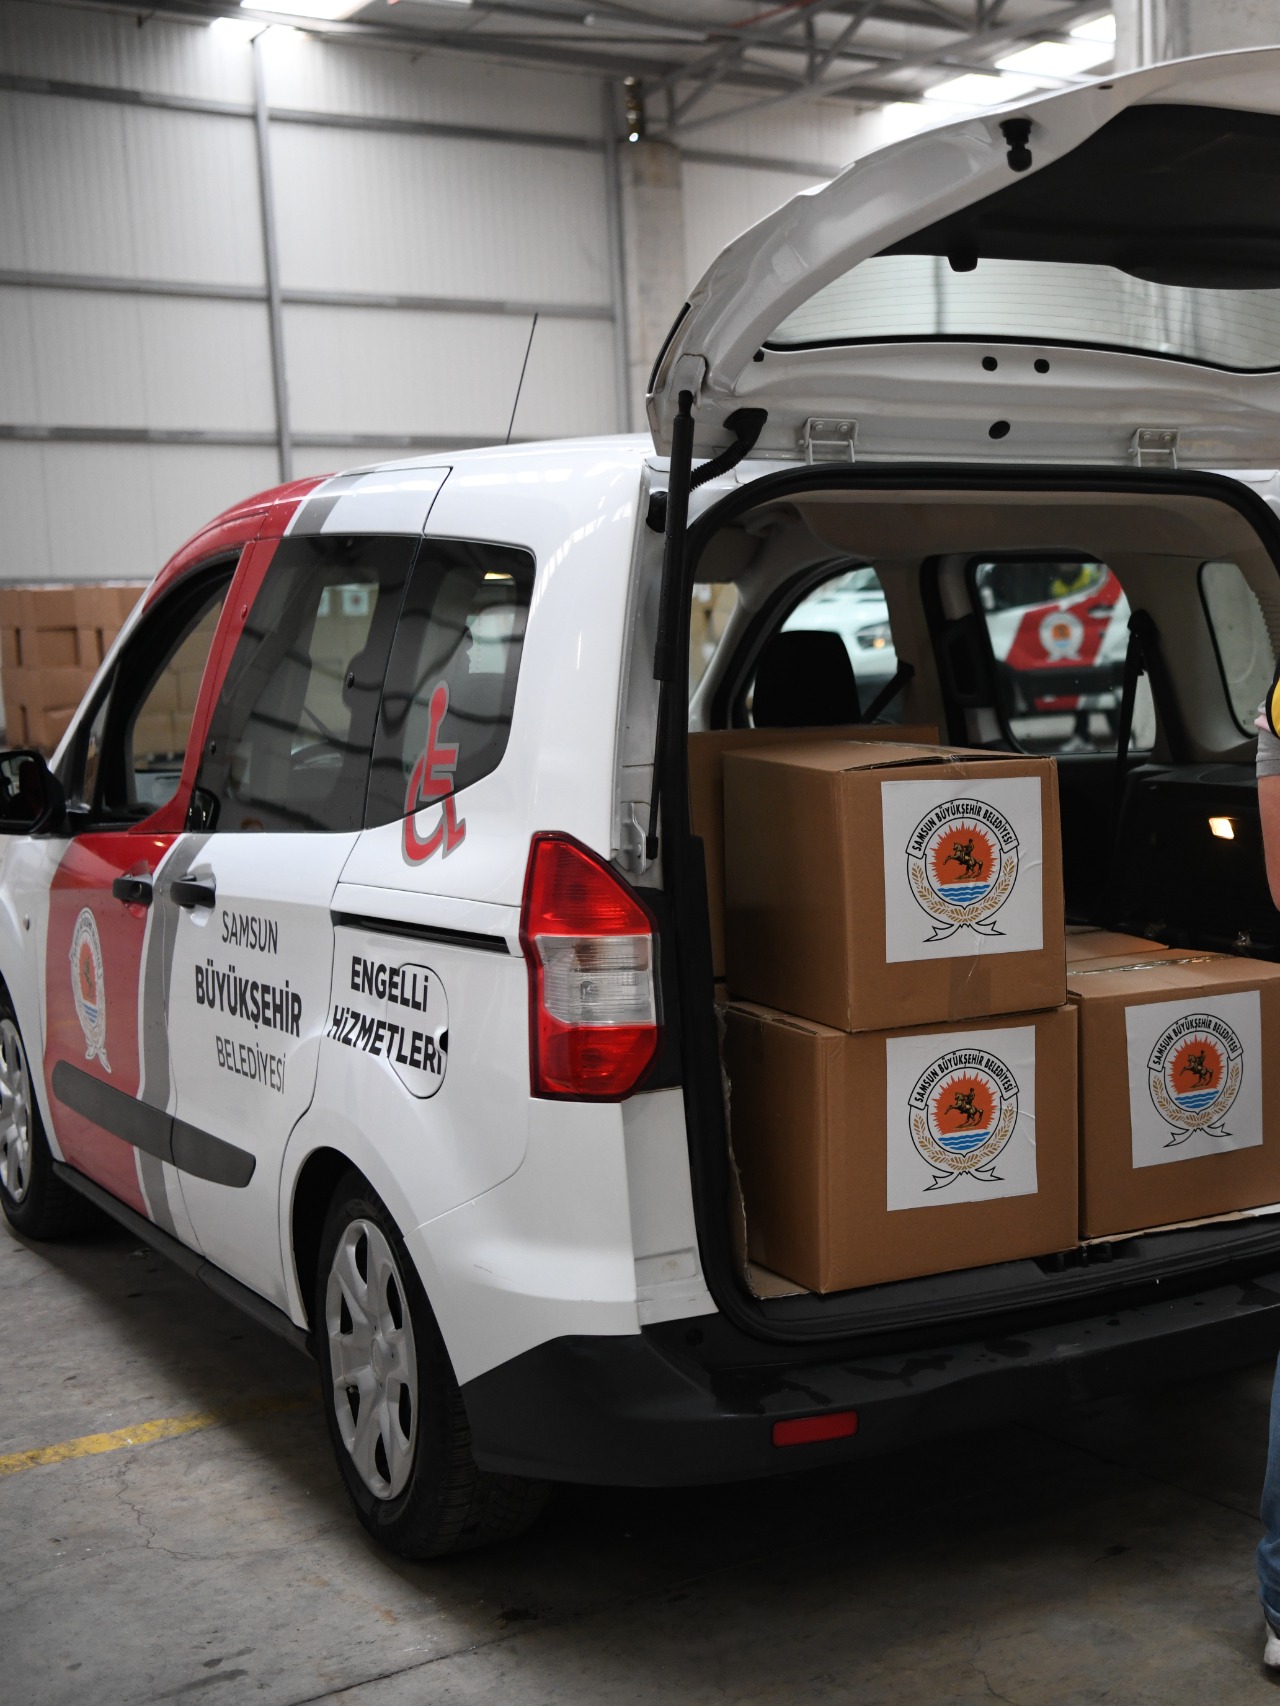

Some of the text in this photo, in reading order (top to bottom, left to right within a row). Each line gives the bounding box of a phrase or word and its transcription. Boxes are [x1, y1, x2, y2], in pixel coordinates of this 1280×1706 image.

[912, 801, 1017, 852] SAMSUN BÜYÜKŞEHİR BELEDİYESİ
[222, 910, 278, 954] SAMSUN
[195, 958, 302, 1038] BÜYÜKŞEHİR
[216, 1035, 286, 1094] BELEDİYESİ
[1152, 1015, 1241, 1065] SAMSUN BÜYÜKŞEHİR BELEDİYESİ
[914, 1051, 1017, 1103] SAMSUN BÜYÜKŞEHİR BELEDİYESİ
